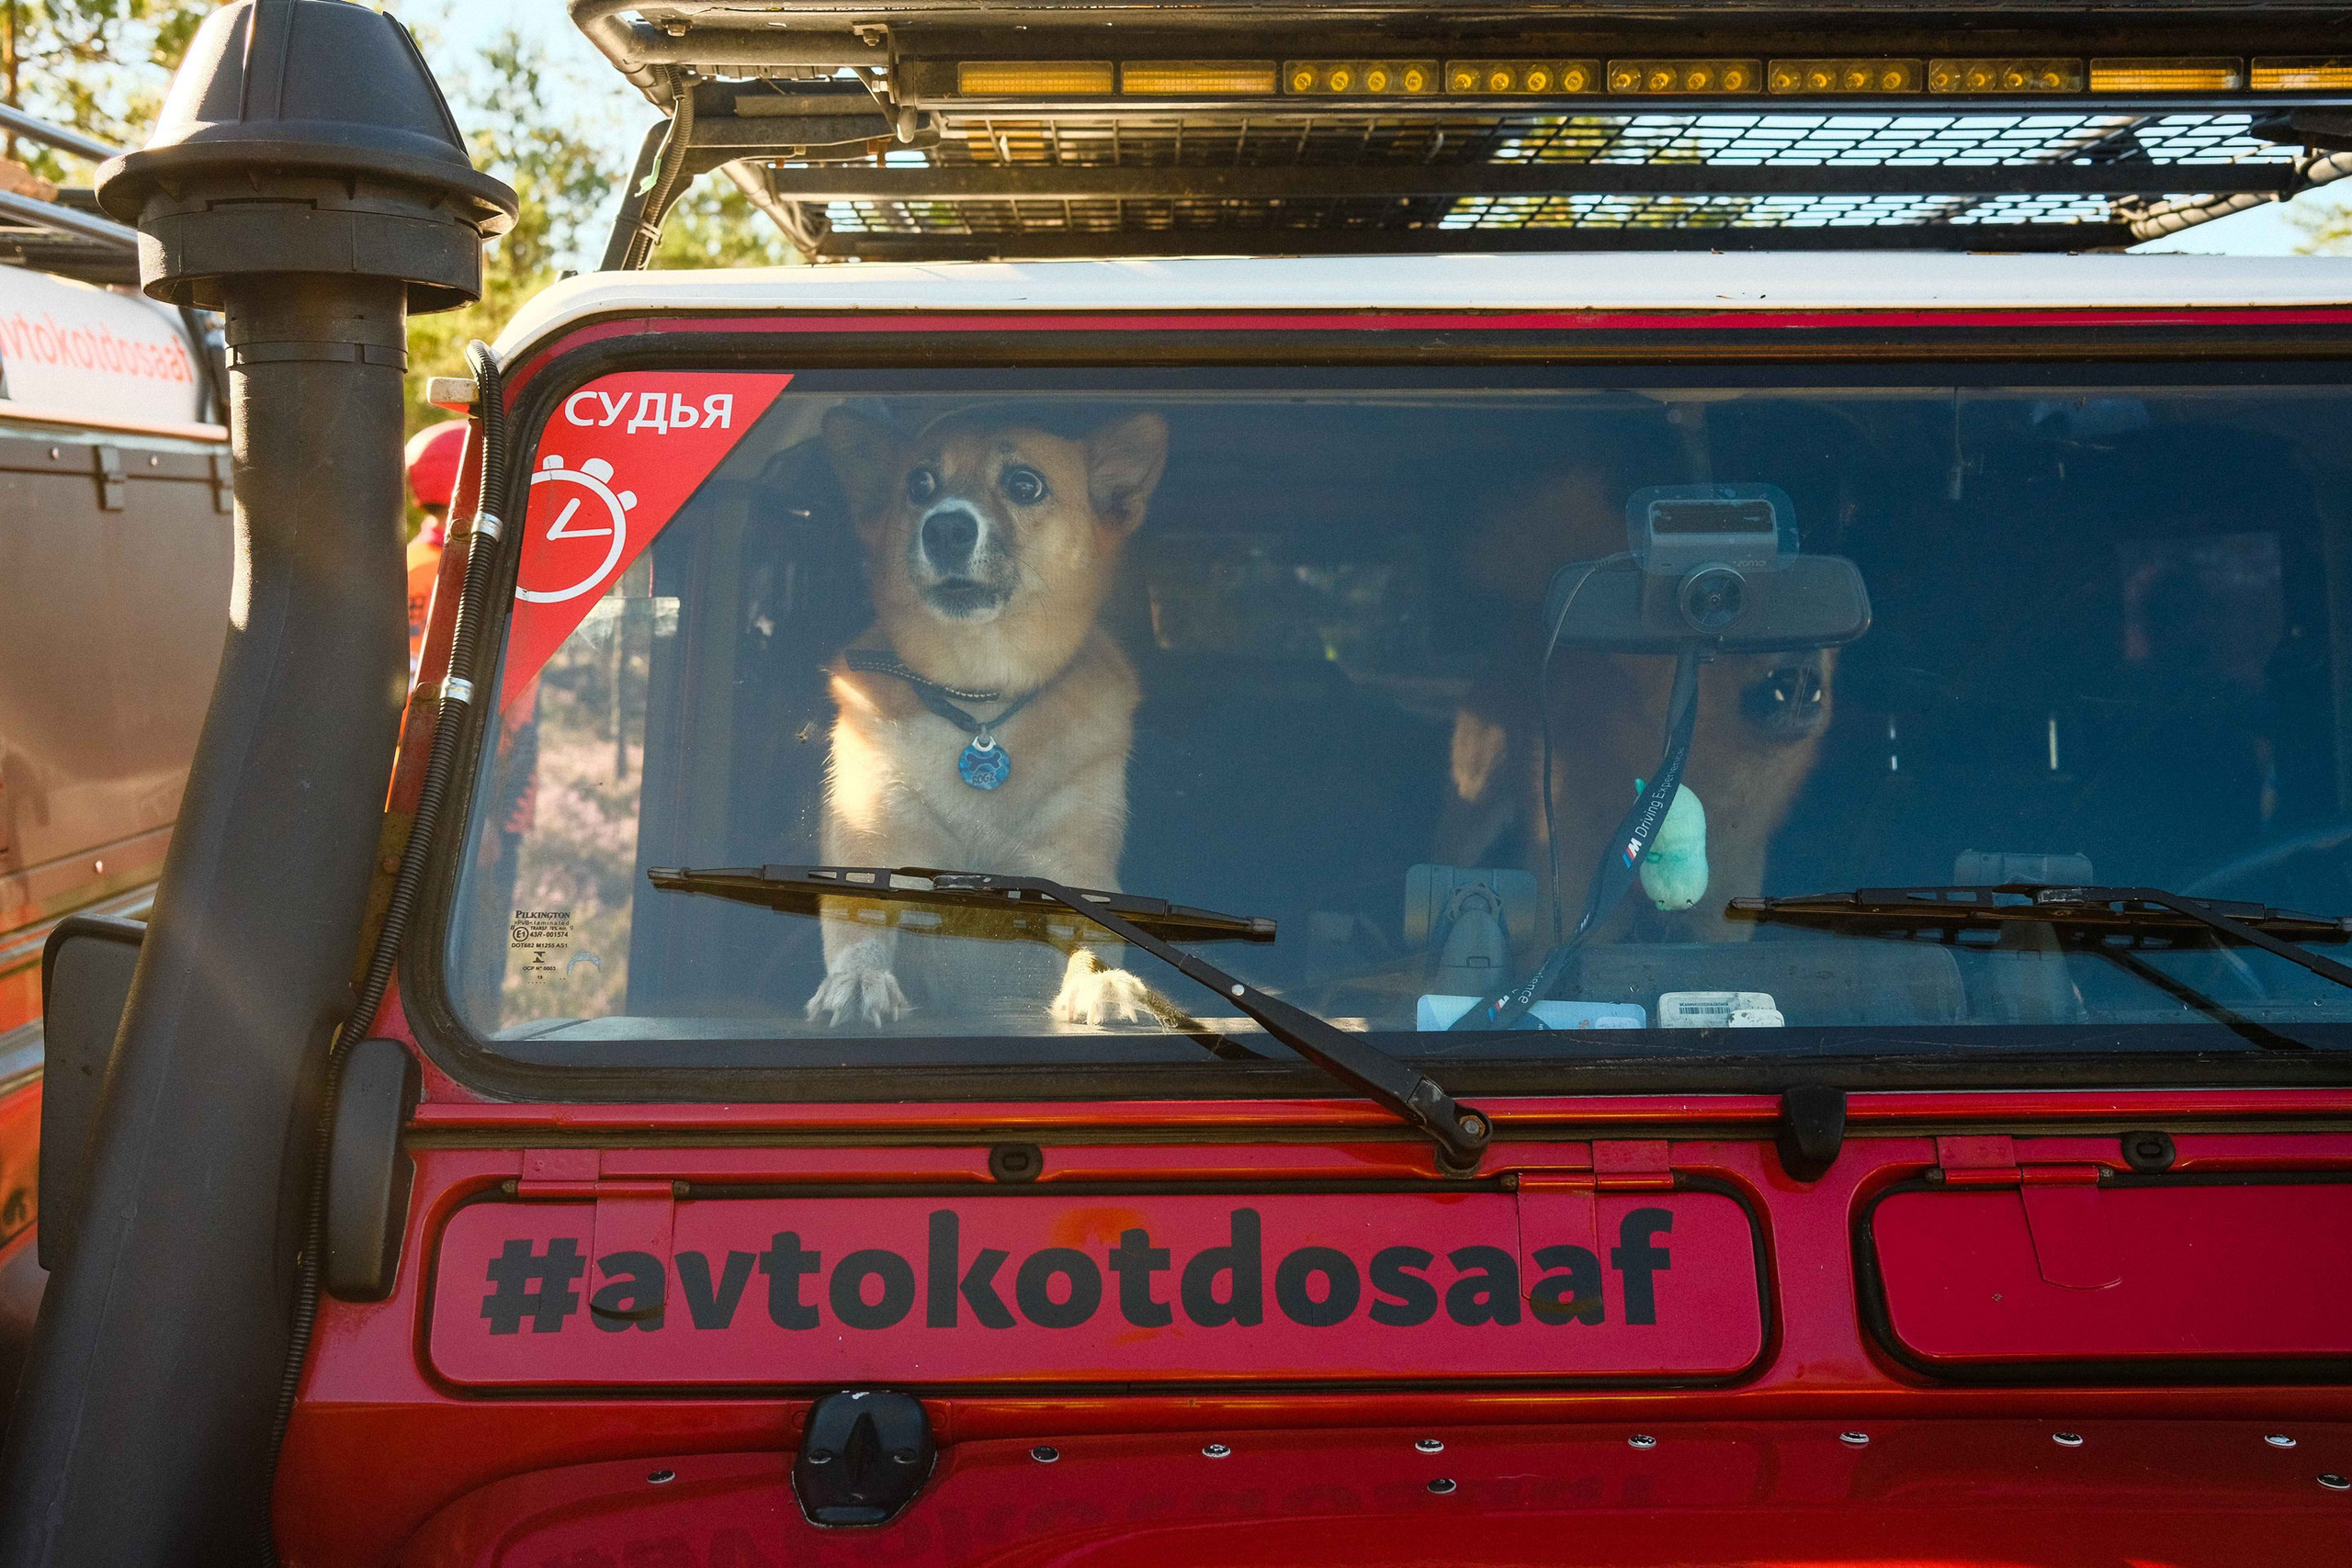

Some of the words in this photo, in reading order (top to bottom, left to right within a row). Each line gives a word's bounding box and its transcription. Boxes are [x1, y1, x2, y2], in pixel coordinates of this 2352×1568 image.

[0, 310, 193, 383] vtokotdosaaf
[564, 390, 733, 434] СУДЬЯ
[1634, 800, 1664, 838] Driving
[516, 930, 526, 938] E1
[480, 1207, 1674, 1336] #avtokotdosaaf
